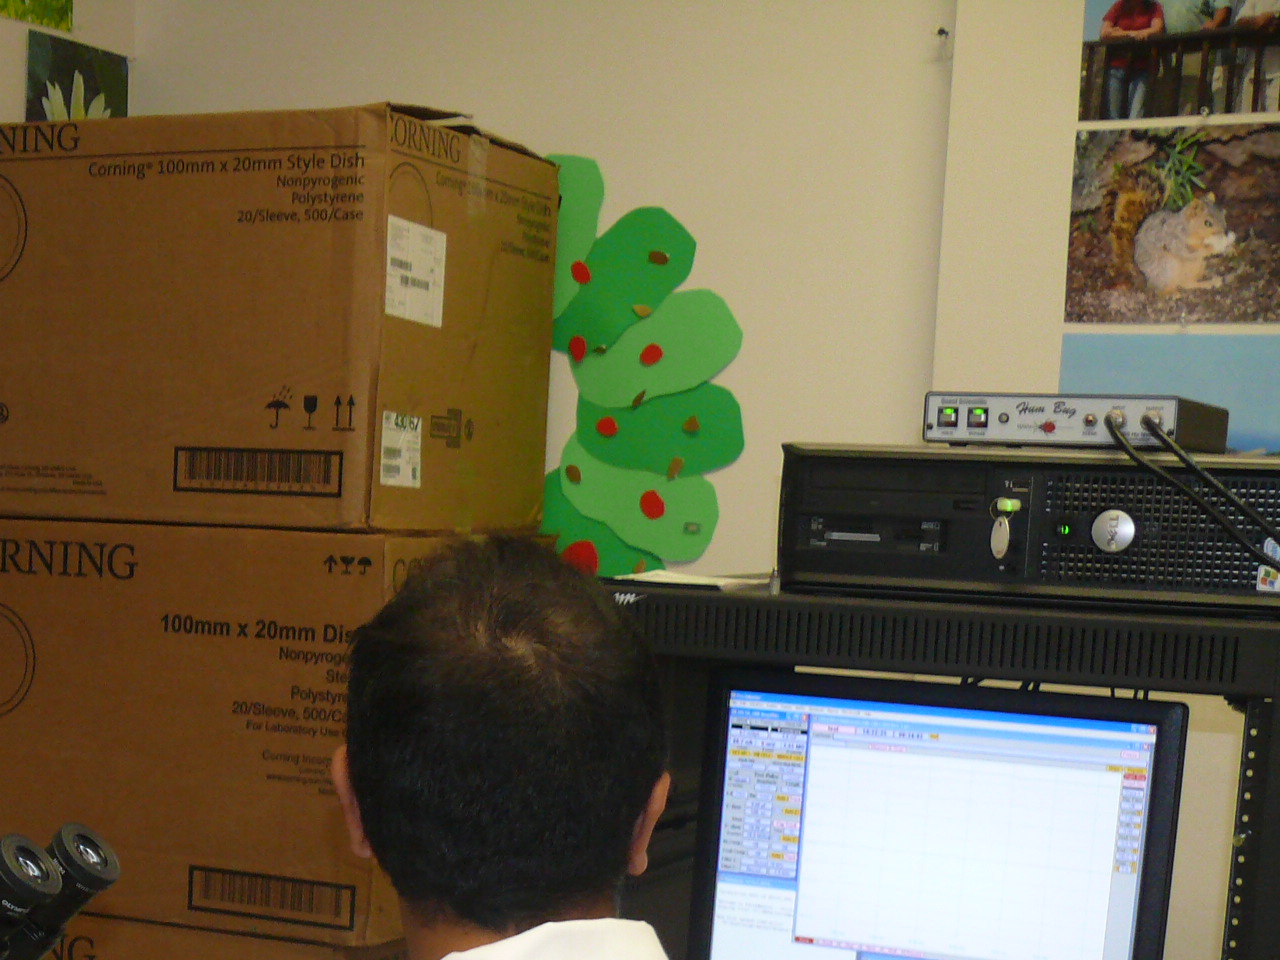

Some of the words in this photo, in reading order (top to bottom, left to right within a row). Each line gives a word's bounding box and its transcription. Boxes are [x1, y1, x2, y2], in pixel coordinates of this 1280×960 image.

[157, 158, 215, 175] 100mm
[219, 161, 228, 173] x
[232, 156, 282, 172] 20mm
[287, 155, 325, 176] Style
[330, 152, 365, 169] Dish
[276, 174, 365, 190] Nonpyrogenic
[291, 190, 364, 207] Polystyrene
[304, 208, 364, 222] 500/Case
[160, 613, 231, 637] 100mm
[236, 622, 249, 638] x
[255, 619, 316, 643] 20mm
[323, 623, 354, 645] Dis
[326, 668, 348, 684] Ste
[302, 706, 347, 723] 500/C
